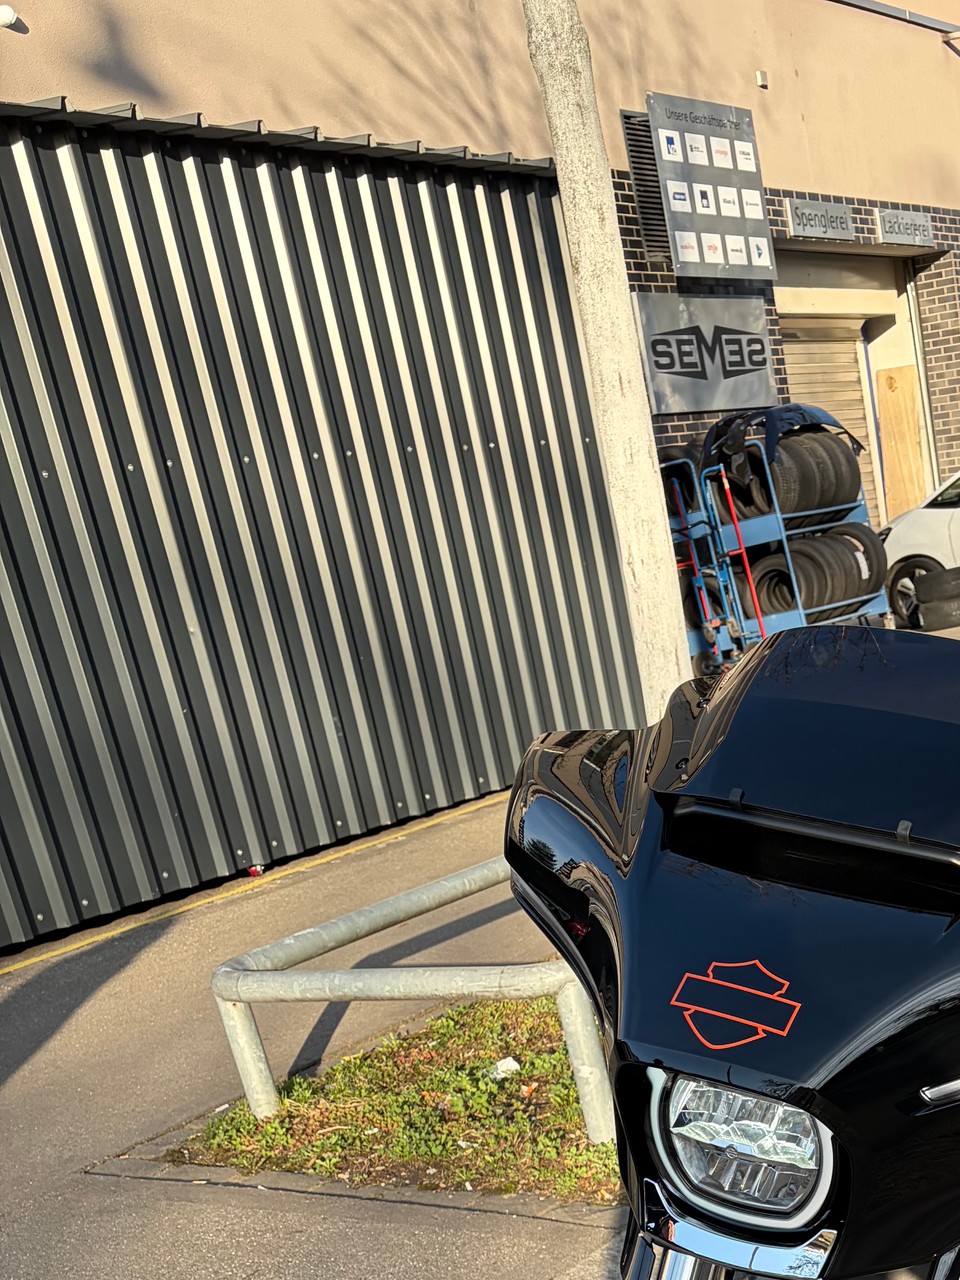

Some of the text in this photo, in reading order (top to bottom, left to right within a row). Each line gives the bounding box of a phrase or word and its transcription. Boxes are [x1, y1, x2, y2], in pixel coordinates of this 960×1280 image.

[665, 107, 740, 130] Unsere Geschäftspartner
[794, 206, 849, 234] Spenglerei
[882, 214, 931, 238] Lackiererei
